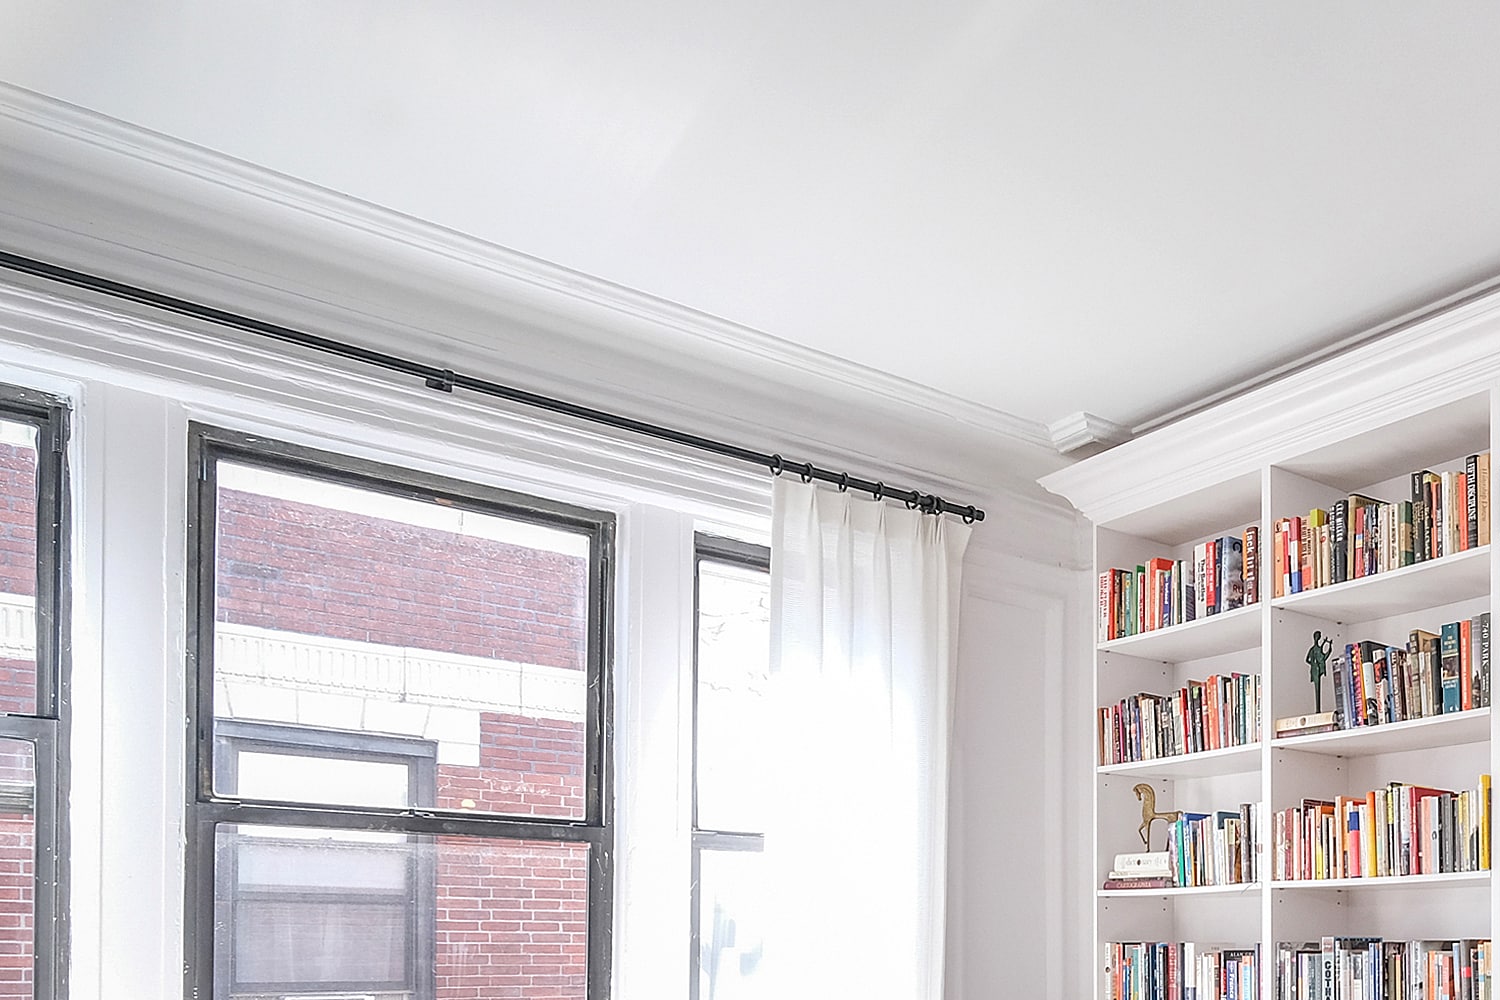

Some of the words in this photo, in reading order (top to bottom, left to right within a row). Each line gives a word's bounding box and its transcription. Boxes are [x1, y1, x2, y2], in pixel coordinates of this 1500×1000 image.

[1467, 463, 1476, 485] FIFTH
[1480, 468, 1488, 501] Watership
[1467, 484, 1476, 522] DISCIPLINE
[1336, 518, 1344, 543] MILLER
